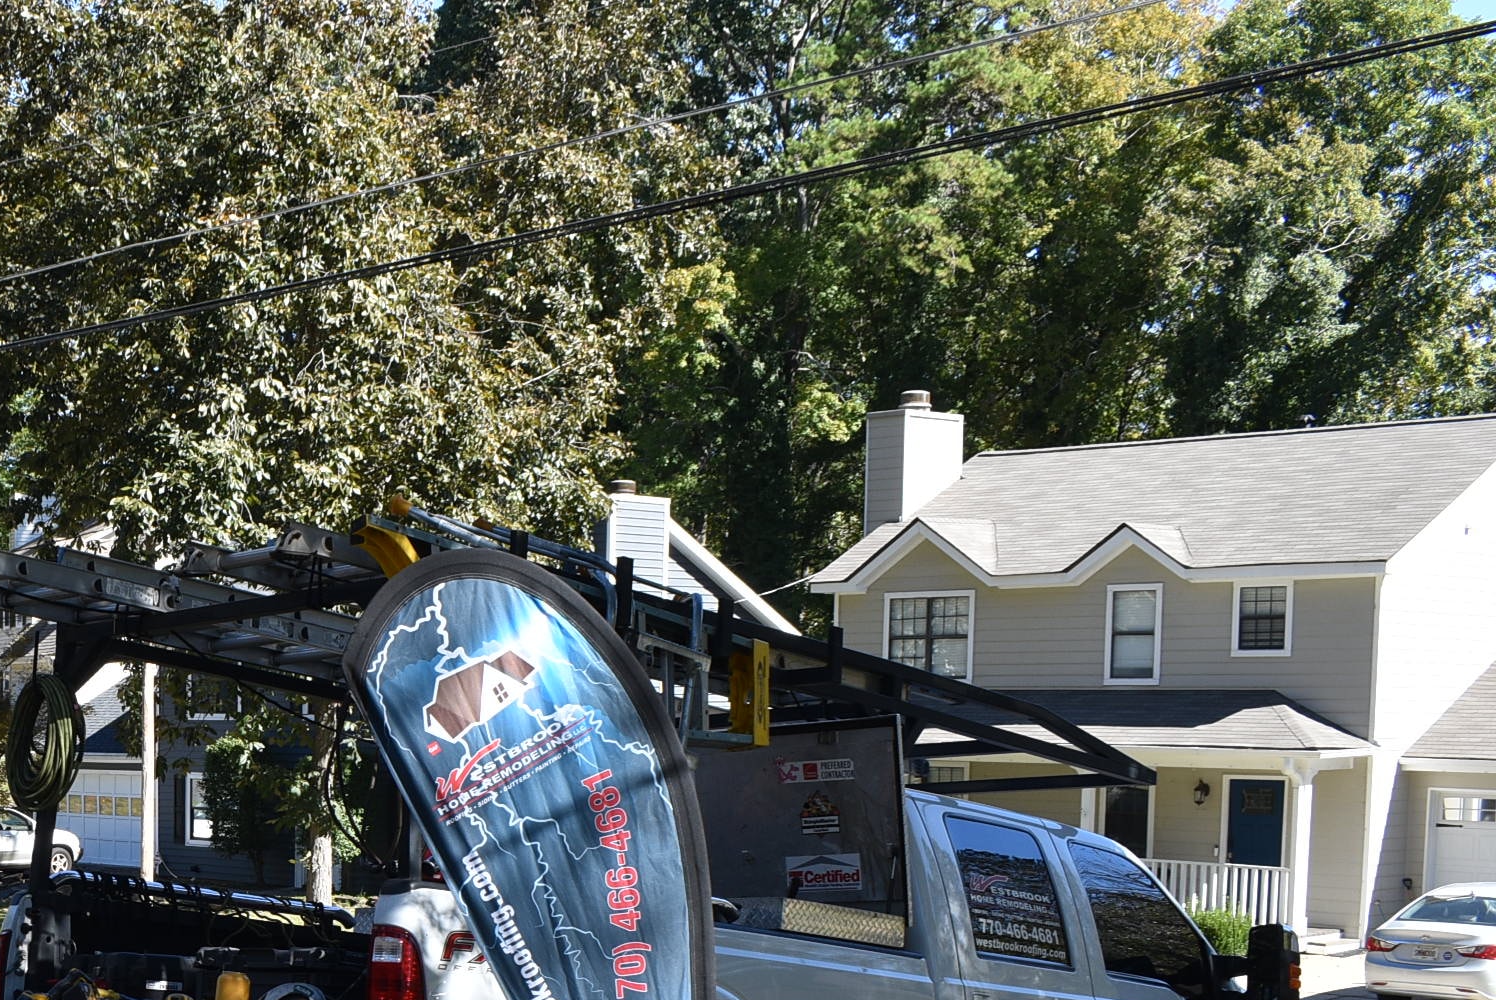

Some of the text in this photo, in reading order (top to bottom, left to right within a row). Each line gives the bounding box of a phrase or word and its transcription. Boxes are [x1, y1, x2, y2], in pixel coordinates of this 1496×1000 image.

[437, 785, 481, 815] HOME
[483, 732, 572, 788] REMODELING
[503, 773, 531, 792] GUTTERS
[535, 753, 563, 774] PAINTING
[820, 760, 851, 769] PREFERRED
[821, 770, 856, 779] CONTRACTOR
[581, 769, 640, 931] 466-4681
[804, 869, 860, 884] Certified
[978, 918, 1060, 945] 770-466-4681
[976, 937, 1066, 959] westbrookroofing.com
